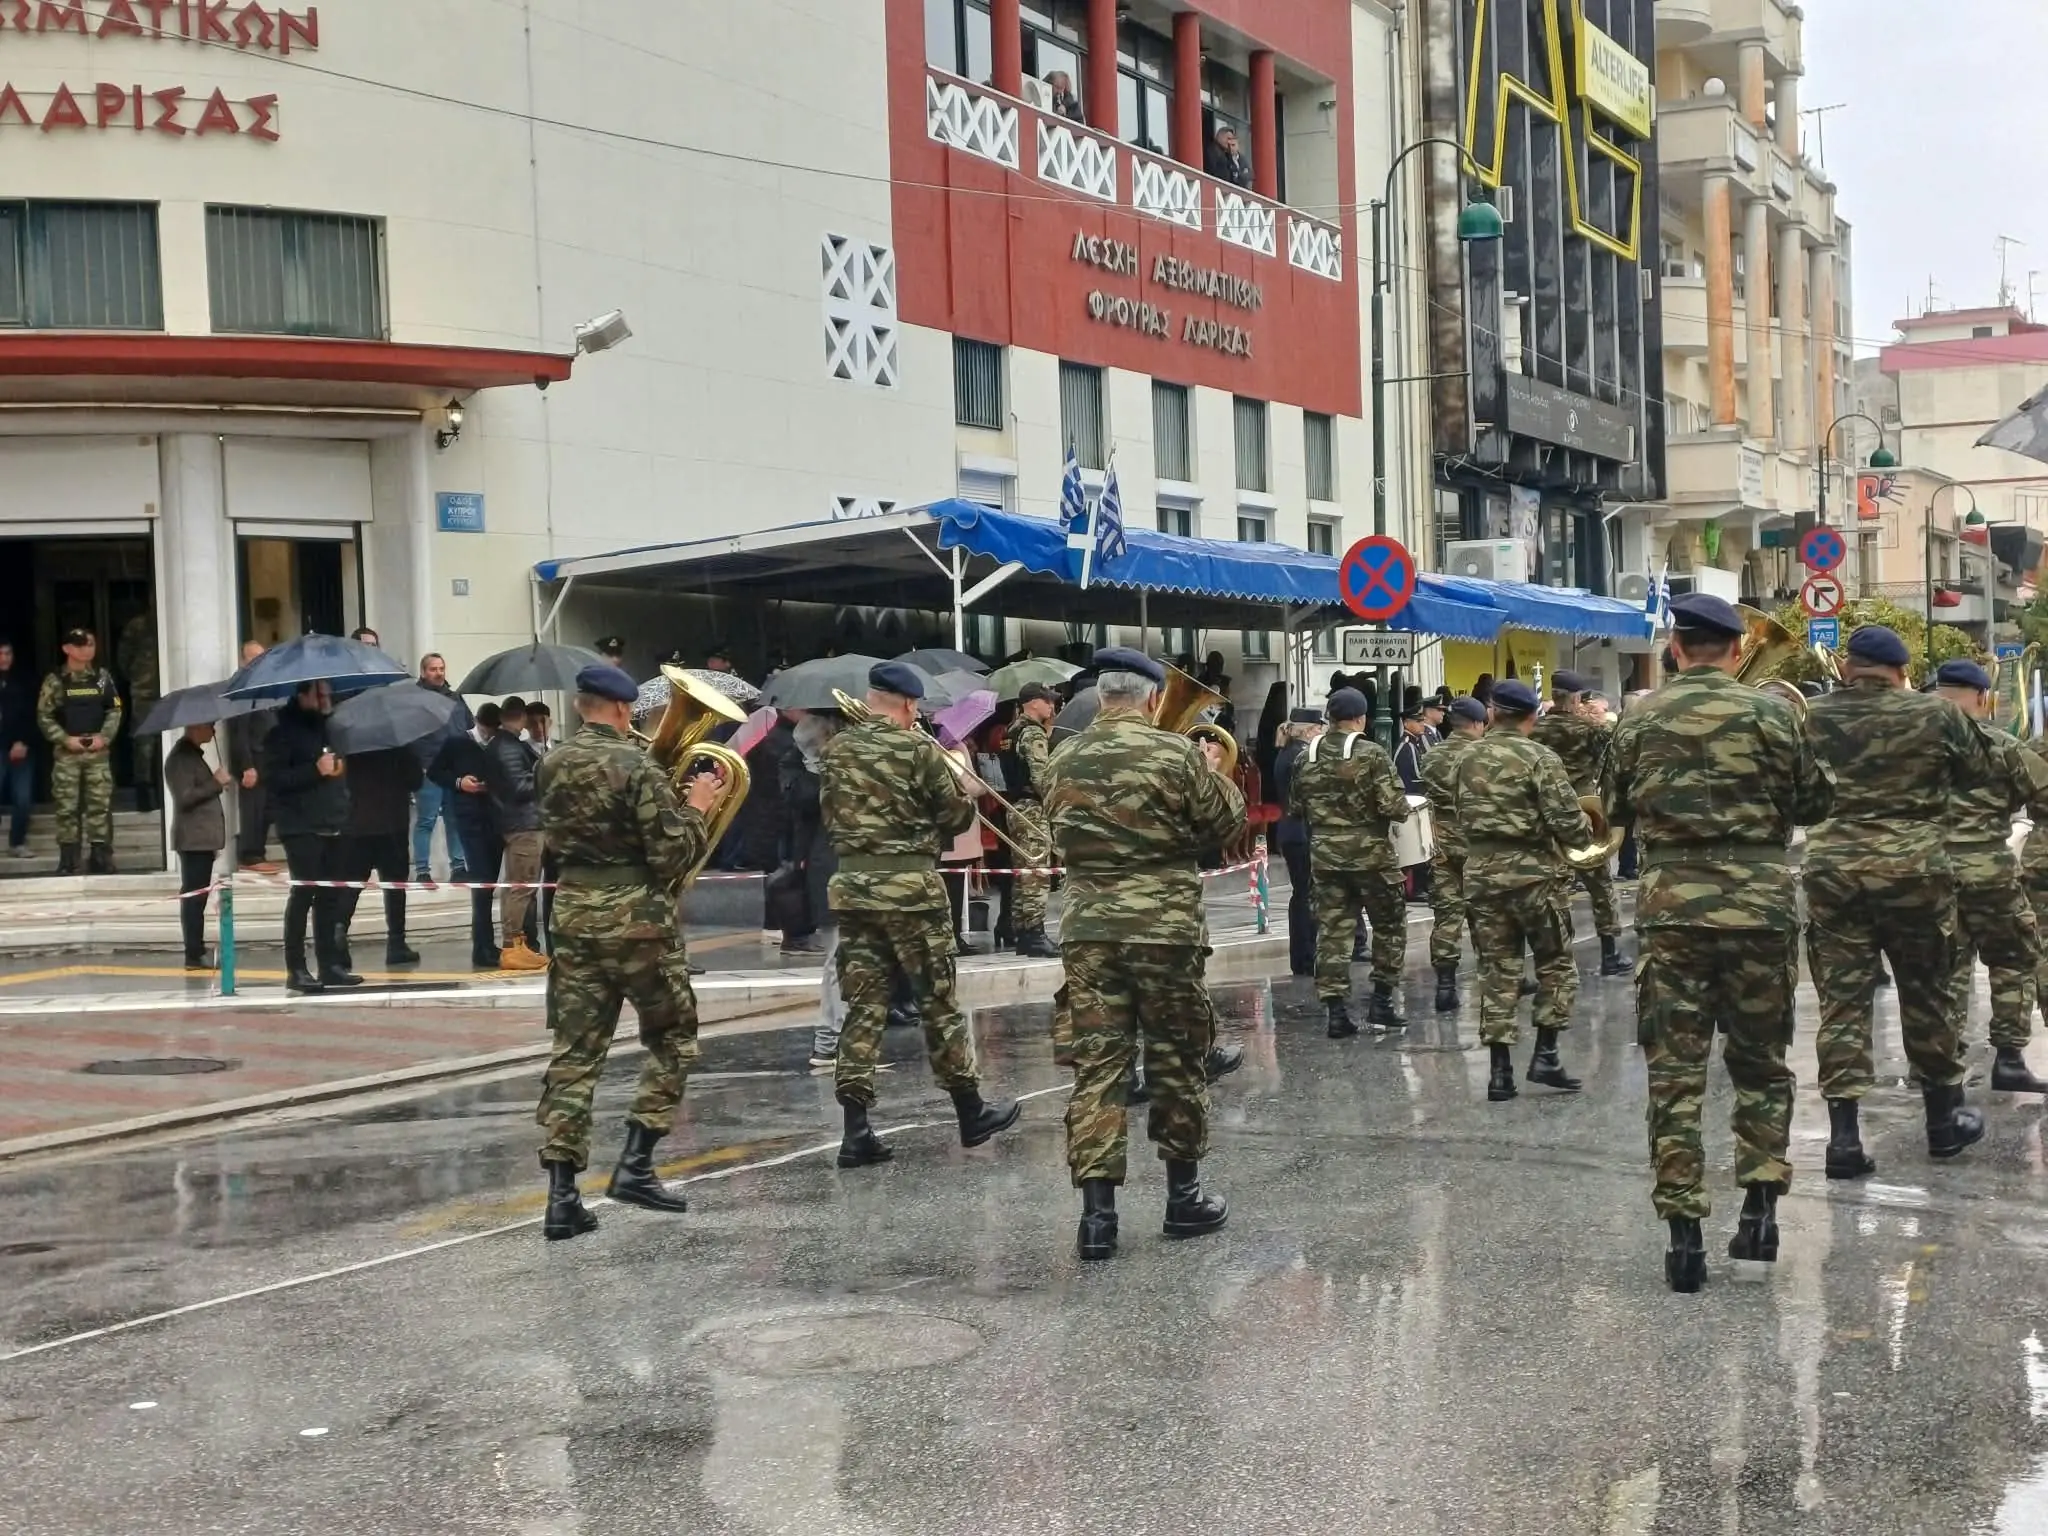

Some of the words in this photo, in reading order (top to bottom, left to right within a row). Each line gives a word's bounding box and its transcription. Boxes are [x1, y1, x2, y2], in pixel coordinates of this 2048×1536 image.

[1591, 38, 1645, 105] ALTERLIFE
[0, 81, 280, 142] ΛΑΡΙΣΑΣ
[1153, 253, 1263, 311] ΑΞΙΩΜΑΤΙΚΩΝ
[1088, 288, 1171, 339] ΦΡΟΥΡΑΣ
[1182, 313, 1253, 359] ΛΑΡΙΣΑΣ
